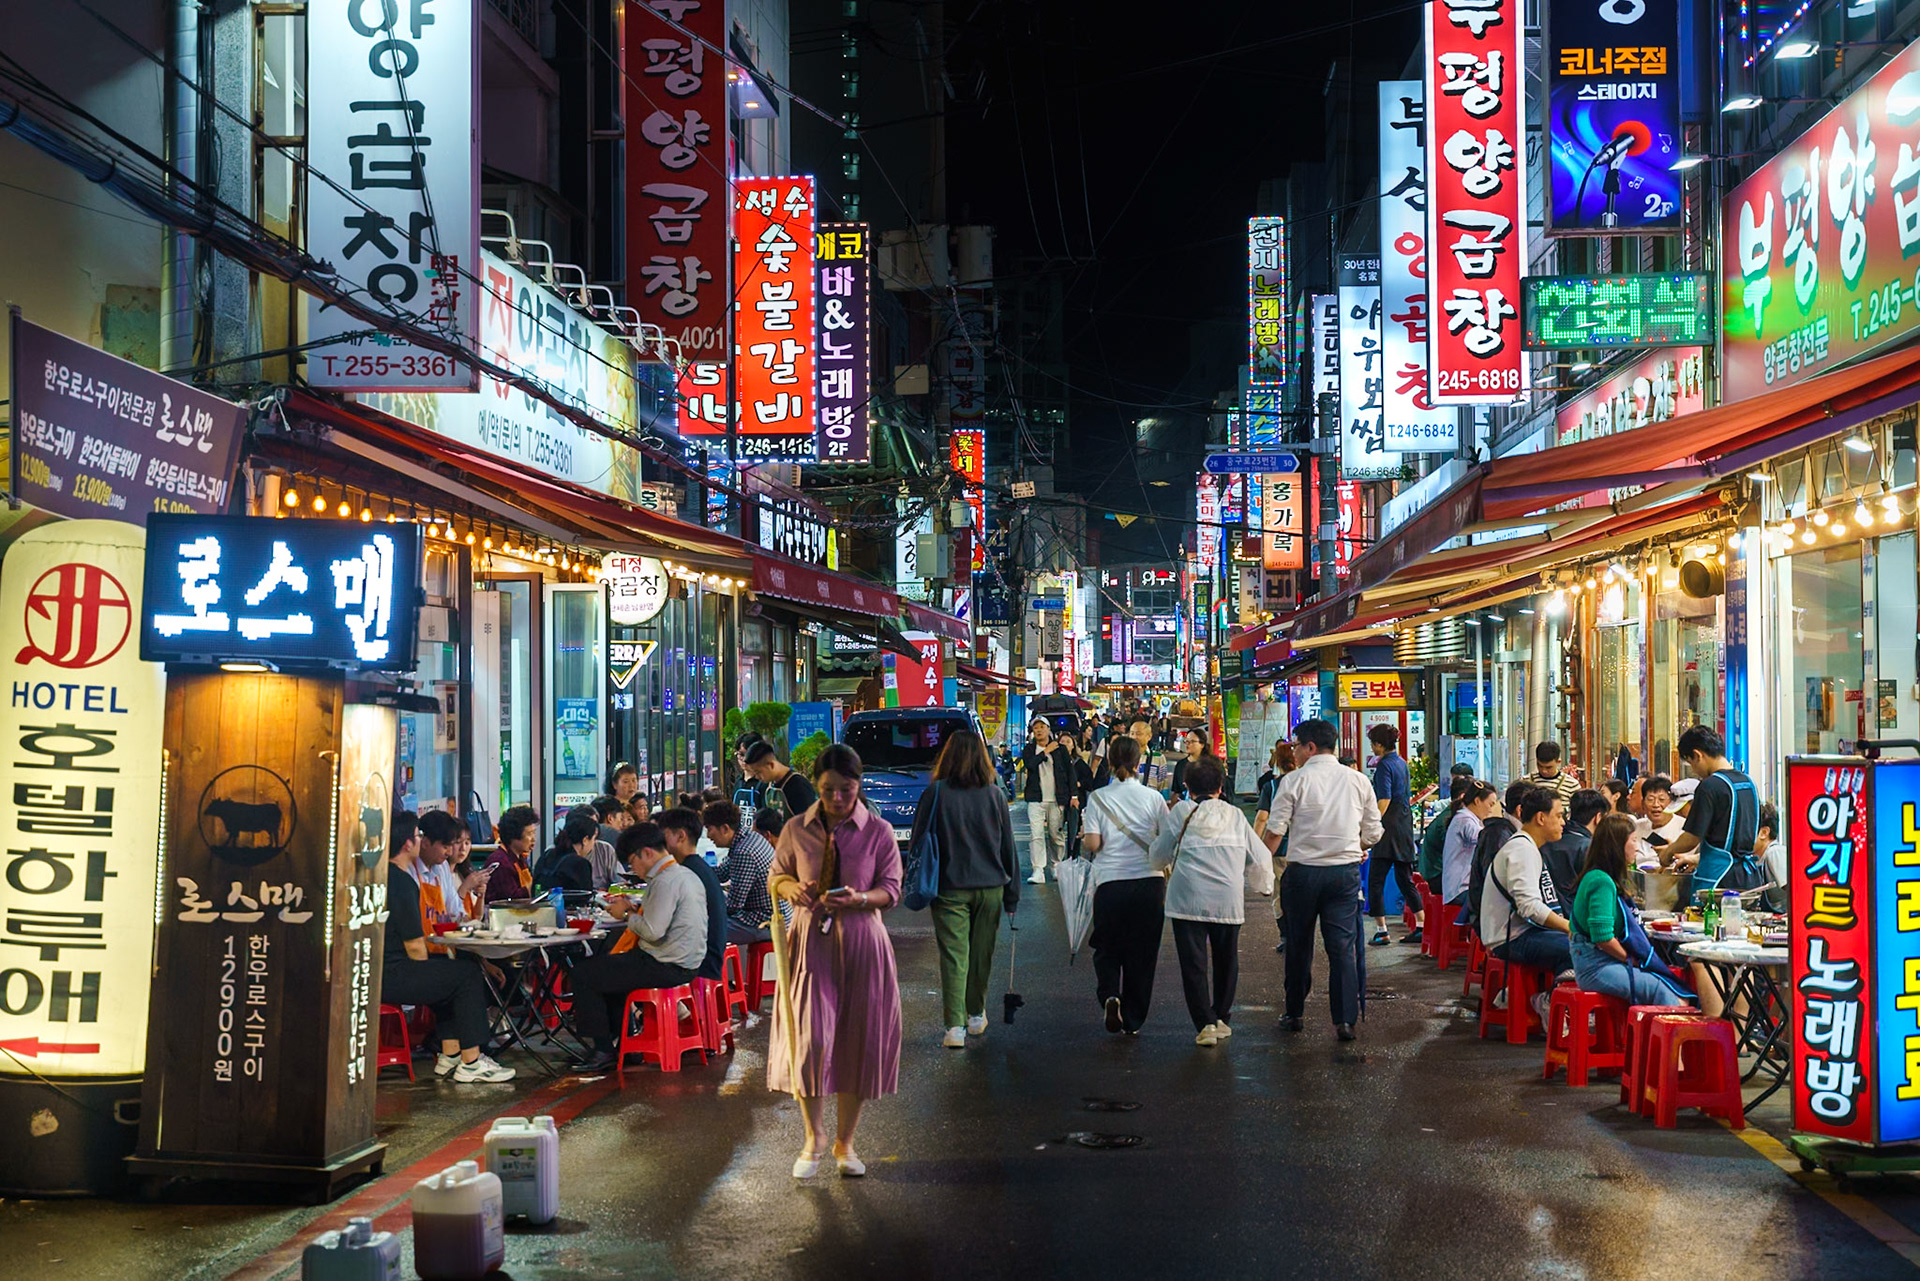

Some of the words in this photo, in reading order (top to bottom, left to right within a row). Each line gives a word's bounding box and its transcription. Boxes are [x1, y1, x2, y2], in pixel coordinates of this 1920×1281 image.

[1560, 47, 1667, 75] 코너주점
[1577, 83, 1657, 100] 스테이지
[343, 0, 435, 303] 양곱창
[745, 186, 808, 218] 생수
[1643, 193, 1673, 218] 2F
[816, 232, 863, 260] 에코
[1344, 260, 1365, 270] 30년
[750, 223, 806, 424] 숯불갈비
[1255, 275, 1280, 345] 노래방
[821, 266, 855, 439] 바&노래방
[1764, 314, 1829, 384] 양곱창전문
[322, 355, 457, 377] T.255-3361
[1438, 370, 1519, 391] 245-6818
[44, 359, 157, 427] 한우로스구이전문점
[156, 393, 214, 453] 로스맨
[1388, 425, 1454, 437] T.246-6842
[20, 409, 76, 459] 한우로스구이
[79, 435, 141, 481] 한우차돌박이
[145, 458, 228, 506] 한우등심로스구이
[526, 426, 573, 475] T.255-3361
[745, 437, 812, 455] 246-1415
[828, 442, 848, 456] 2F
[1209, 460, 1219, 468] 26
[1226, 456, 1277, 467] 중구로23번길
[1345, 467, 1401, 478] T.246-8649
[612, 556, 642, 573] 대정
[153, 534, 394, 661] 로스맨
[600, 575, 660, 598] 양곱창
[610, 644, 644, 661] ERRA
[834, 642, 877, 650] 051-245-
[12, 681, 128, 714] HOTEL
[1351, 680, 1405, 699] 굴보쌈
[1806, 795, 1856, 929] 아지트
[176, 877, 313, 923] 로스맨
[213, 936, 236, 1081] 12900원
[243, 934, 270, 1081] 한우로스구이
[1799, 935, 1861, 1119] 노래방
